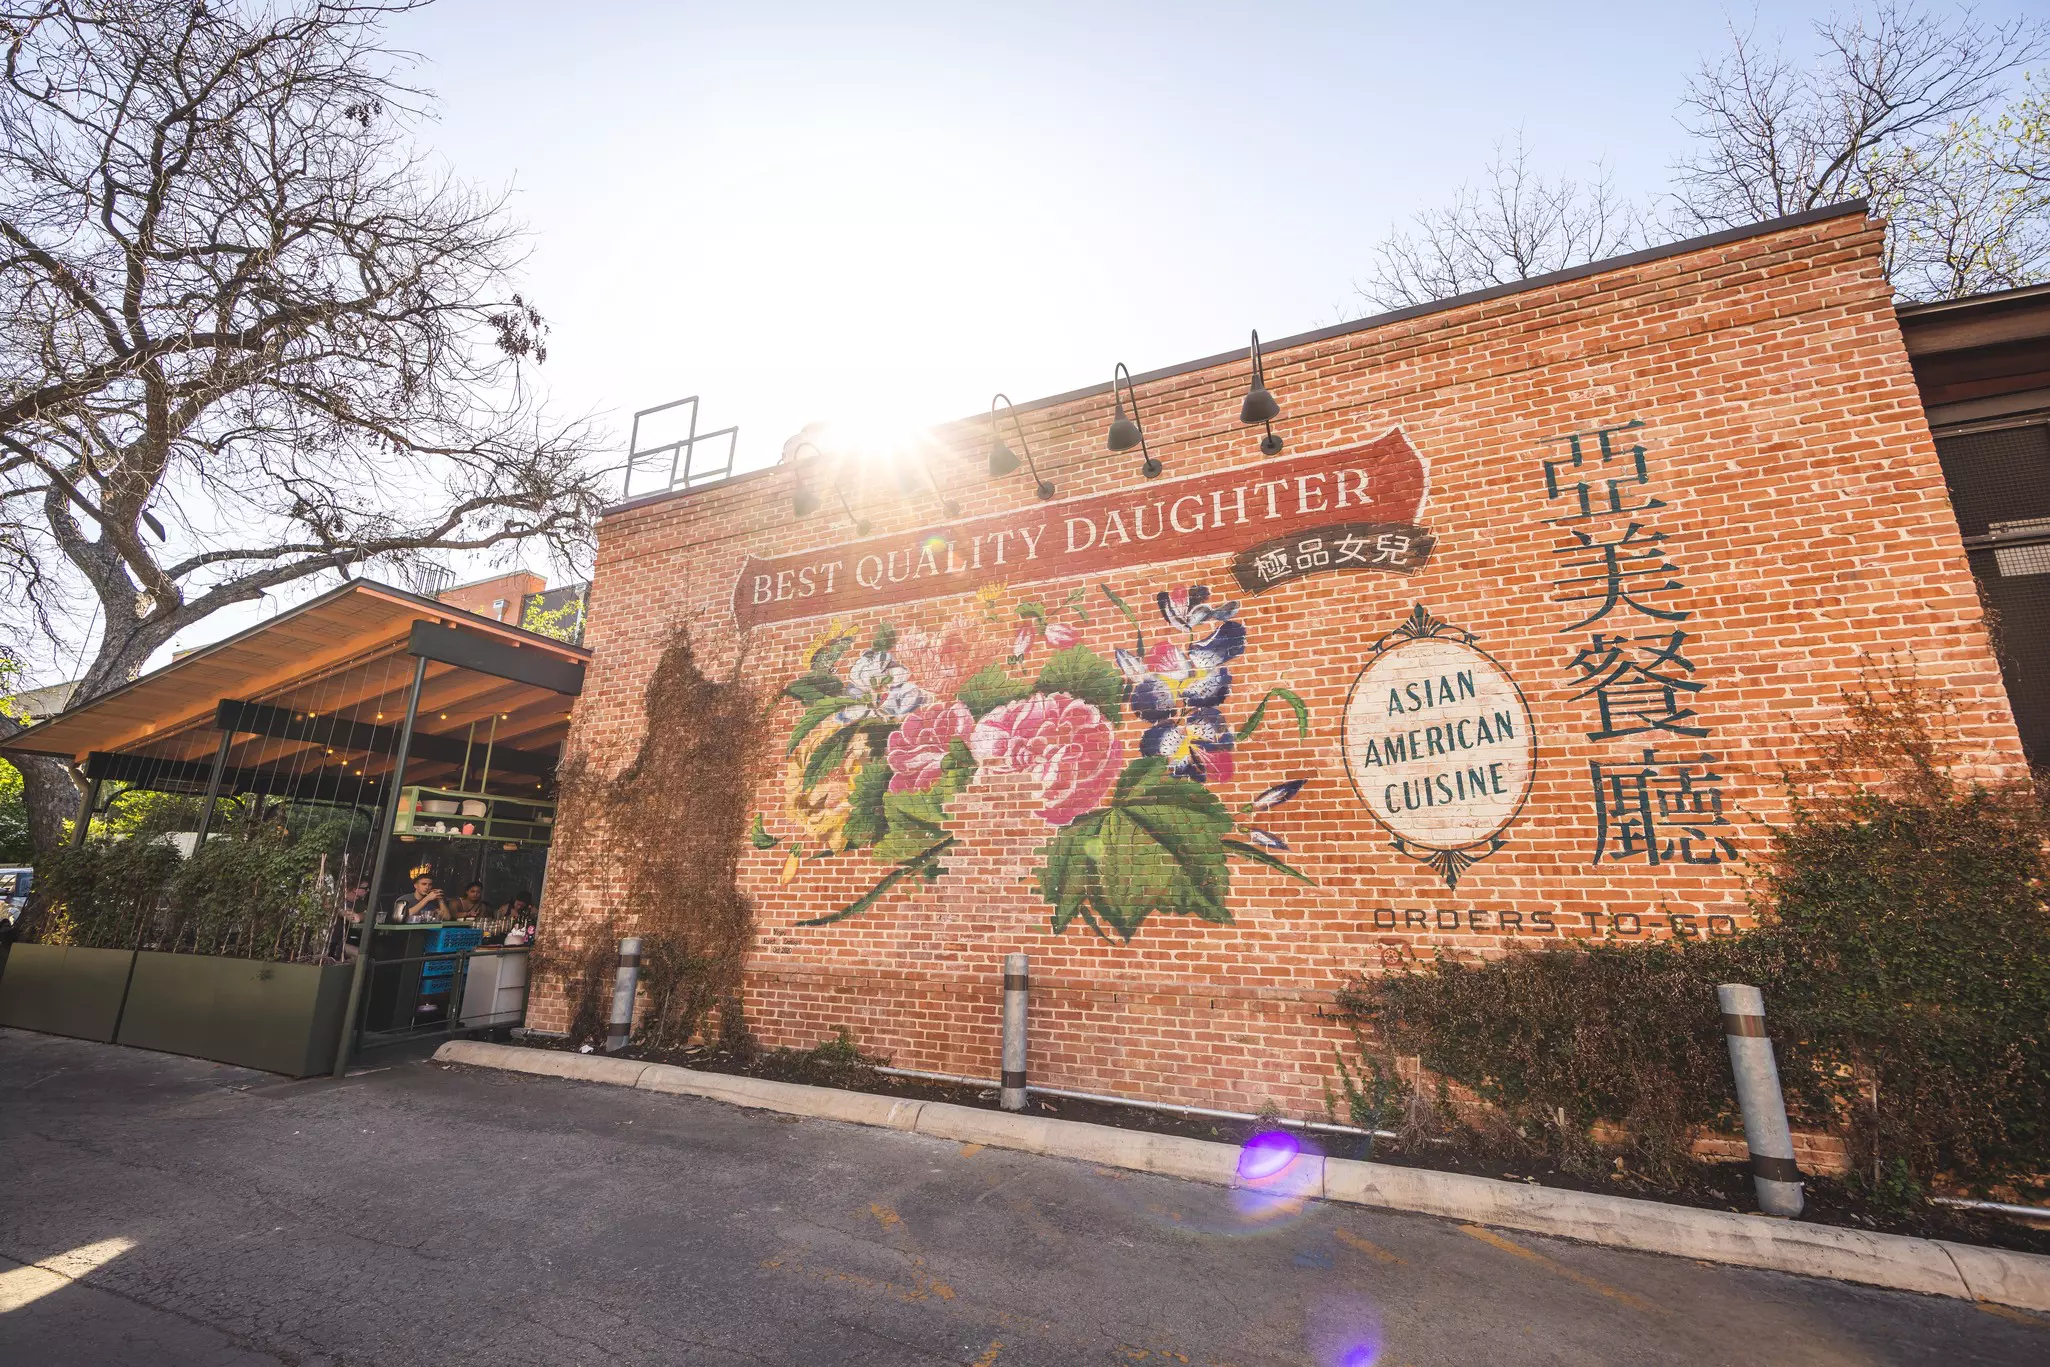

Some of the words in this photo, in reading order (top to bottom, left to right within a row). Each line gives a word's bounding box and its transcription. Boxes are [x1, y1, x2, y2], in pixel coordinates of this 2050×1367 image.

[752, 562, 843, 605] BEST
[855, 523, 1048, 590] QUALITY
[1064, 468, 1374, 554] DAUGHTER
[1253, 532, 1411, 583] 極品女兒
[1535, 419, 1738, 866] 亞美餐廳
[1387, 669, 1476, 717] ASIAN
[1364, 710, 1515, 768] AMERICAN
[1385, 762, 1508, 814] CUISINE
[1374, 908, 1556, 933] ORDERS
[1583, 911, 1738, 939] TO-GO
